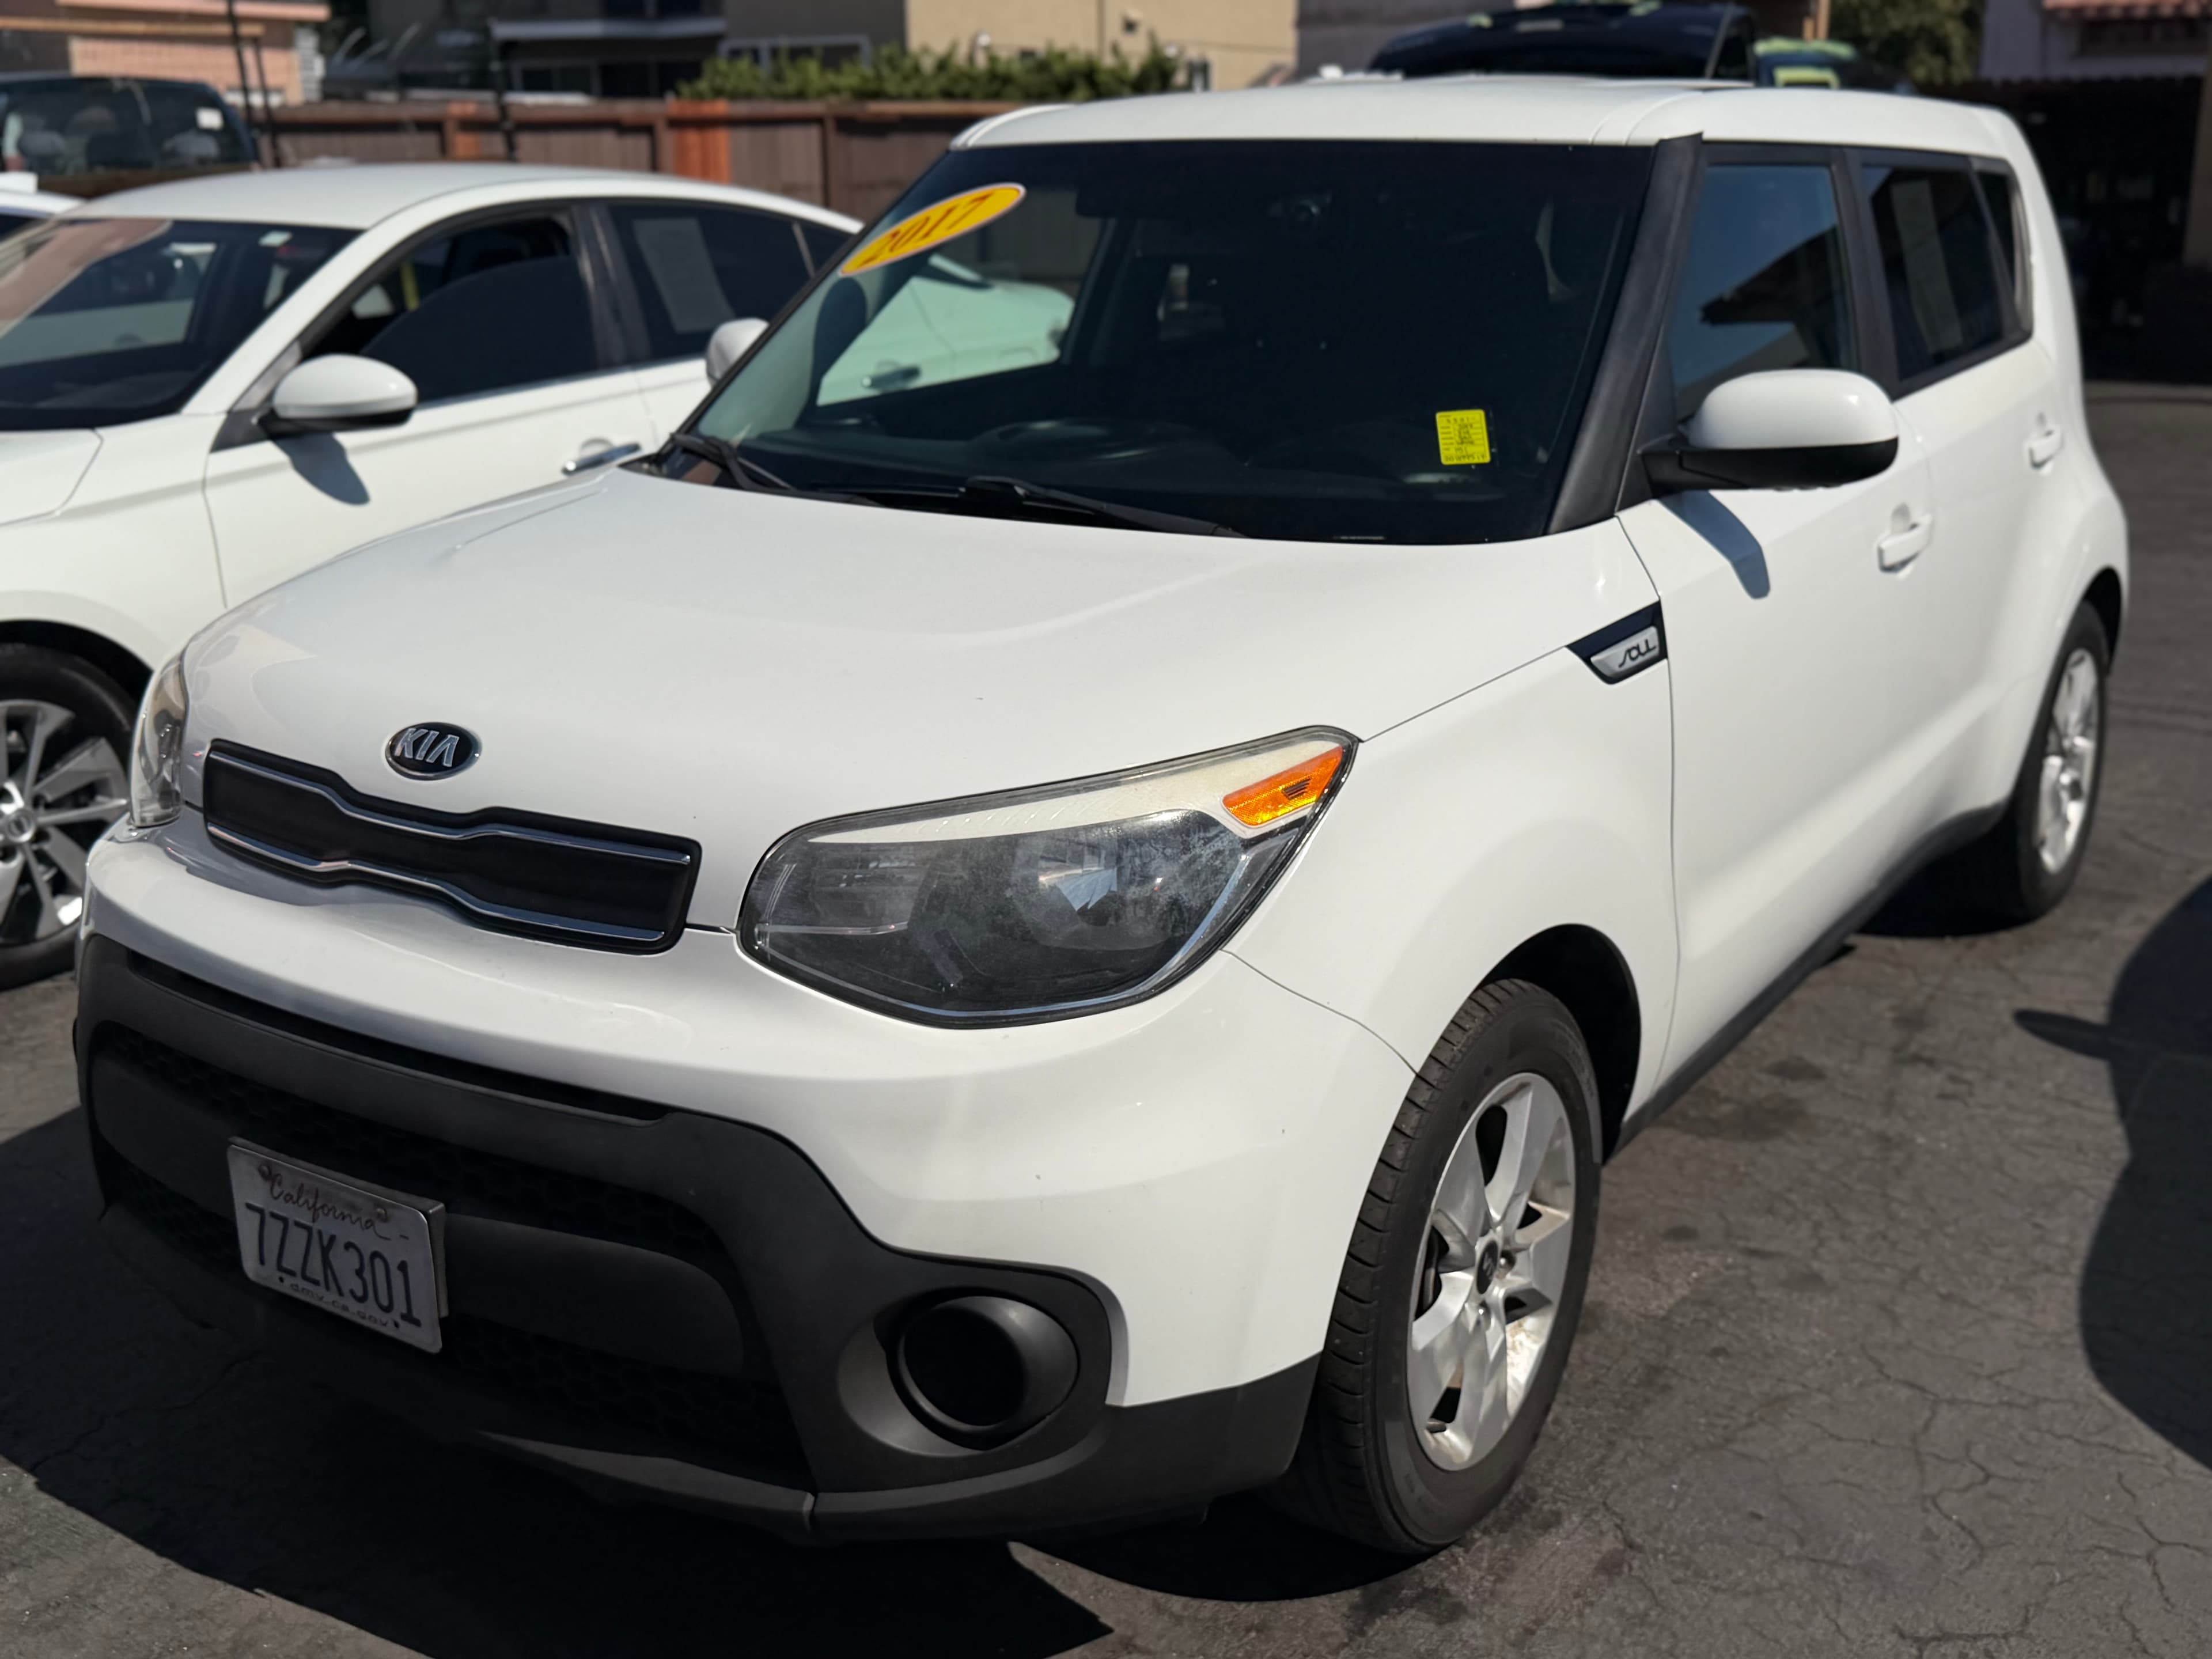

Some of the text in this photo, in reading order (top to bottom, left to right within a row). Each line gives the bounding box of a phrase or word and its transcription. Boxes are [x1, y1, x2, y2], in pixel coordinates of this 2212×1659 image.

[857, 192, 994, 268] 2017
[394, 728, 460, 767] KIA
[270, 1173, 392, 1240] California
[245, 1202, 422, 1327] 7ZZK301
